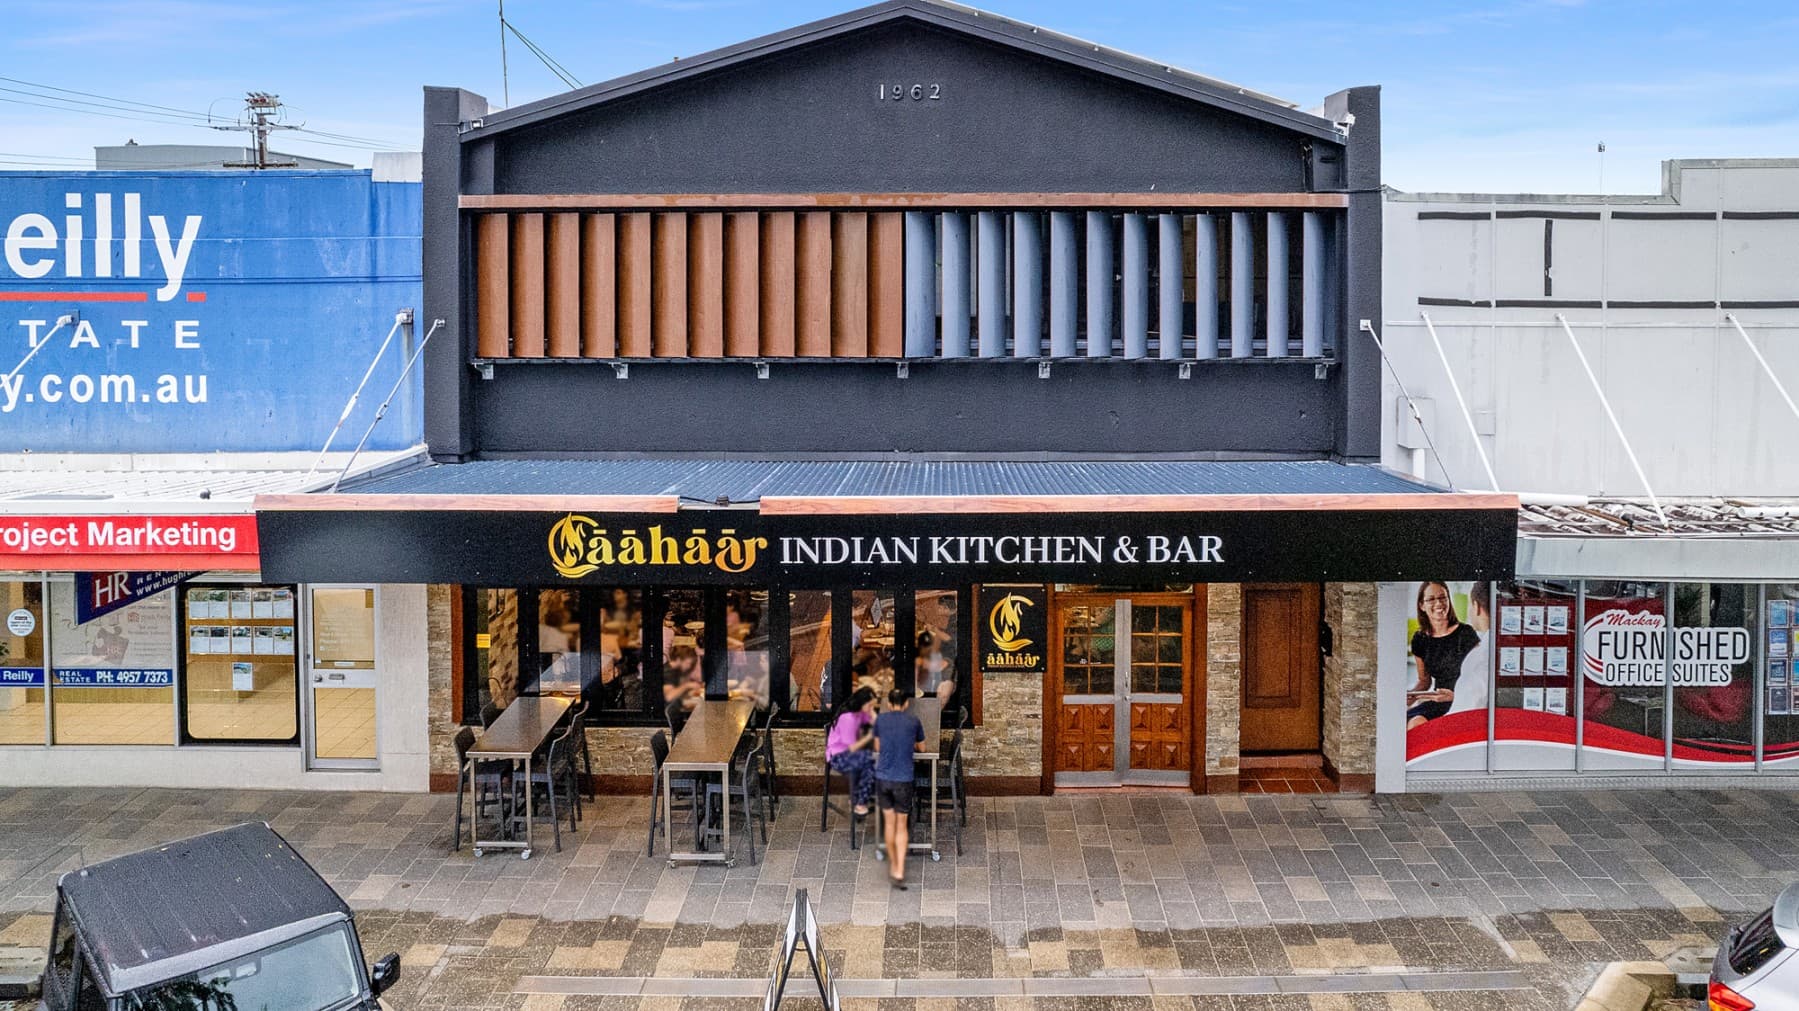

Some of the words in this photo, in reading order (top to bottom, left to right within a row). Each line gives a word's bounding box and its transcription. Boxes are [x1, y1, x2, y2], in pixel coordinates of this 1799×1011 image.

[880, 84, 941, 100] 1962
[5, 193, 203, 301] eilly
[19, 320, 201, 349] TATE
[87, 520, 236, 552] Marketing
[779, 536, 920, 565] INDIAN
[928, 535, 1105, 565] KITCHEN
[1112, 535, 1139, 564] &
[1146, 535, 1225, 563] BAR
[95, 571, 133, 608] HR
[1607, 613, 1662, 629] Mackay
[1598, 631, 1747, 660] FURNISHED
[2, 670, 34, 683] Reilly
[96, 671, 114, 683] PH:
[117, 671, 140, 683] 4957
[144, 671, 168, 683] 7373
[1606, 663, 1663, 682] OFFICE
[1672, 663, 1729, 682] SUITES
